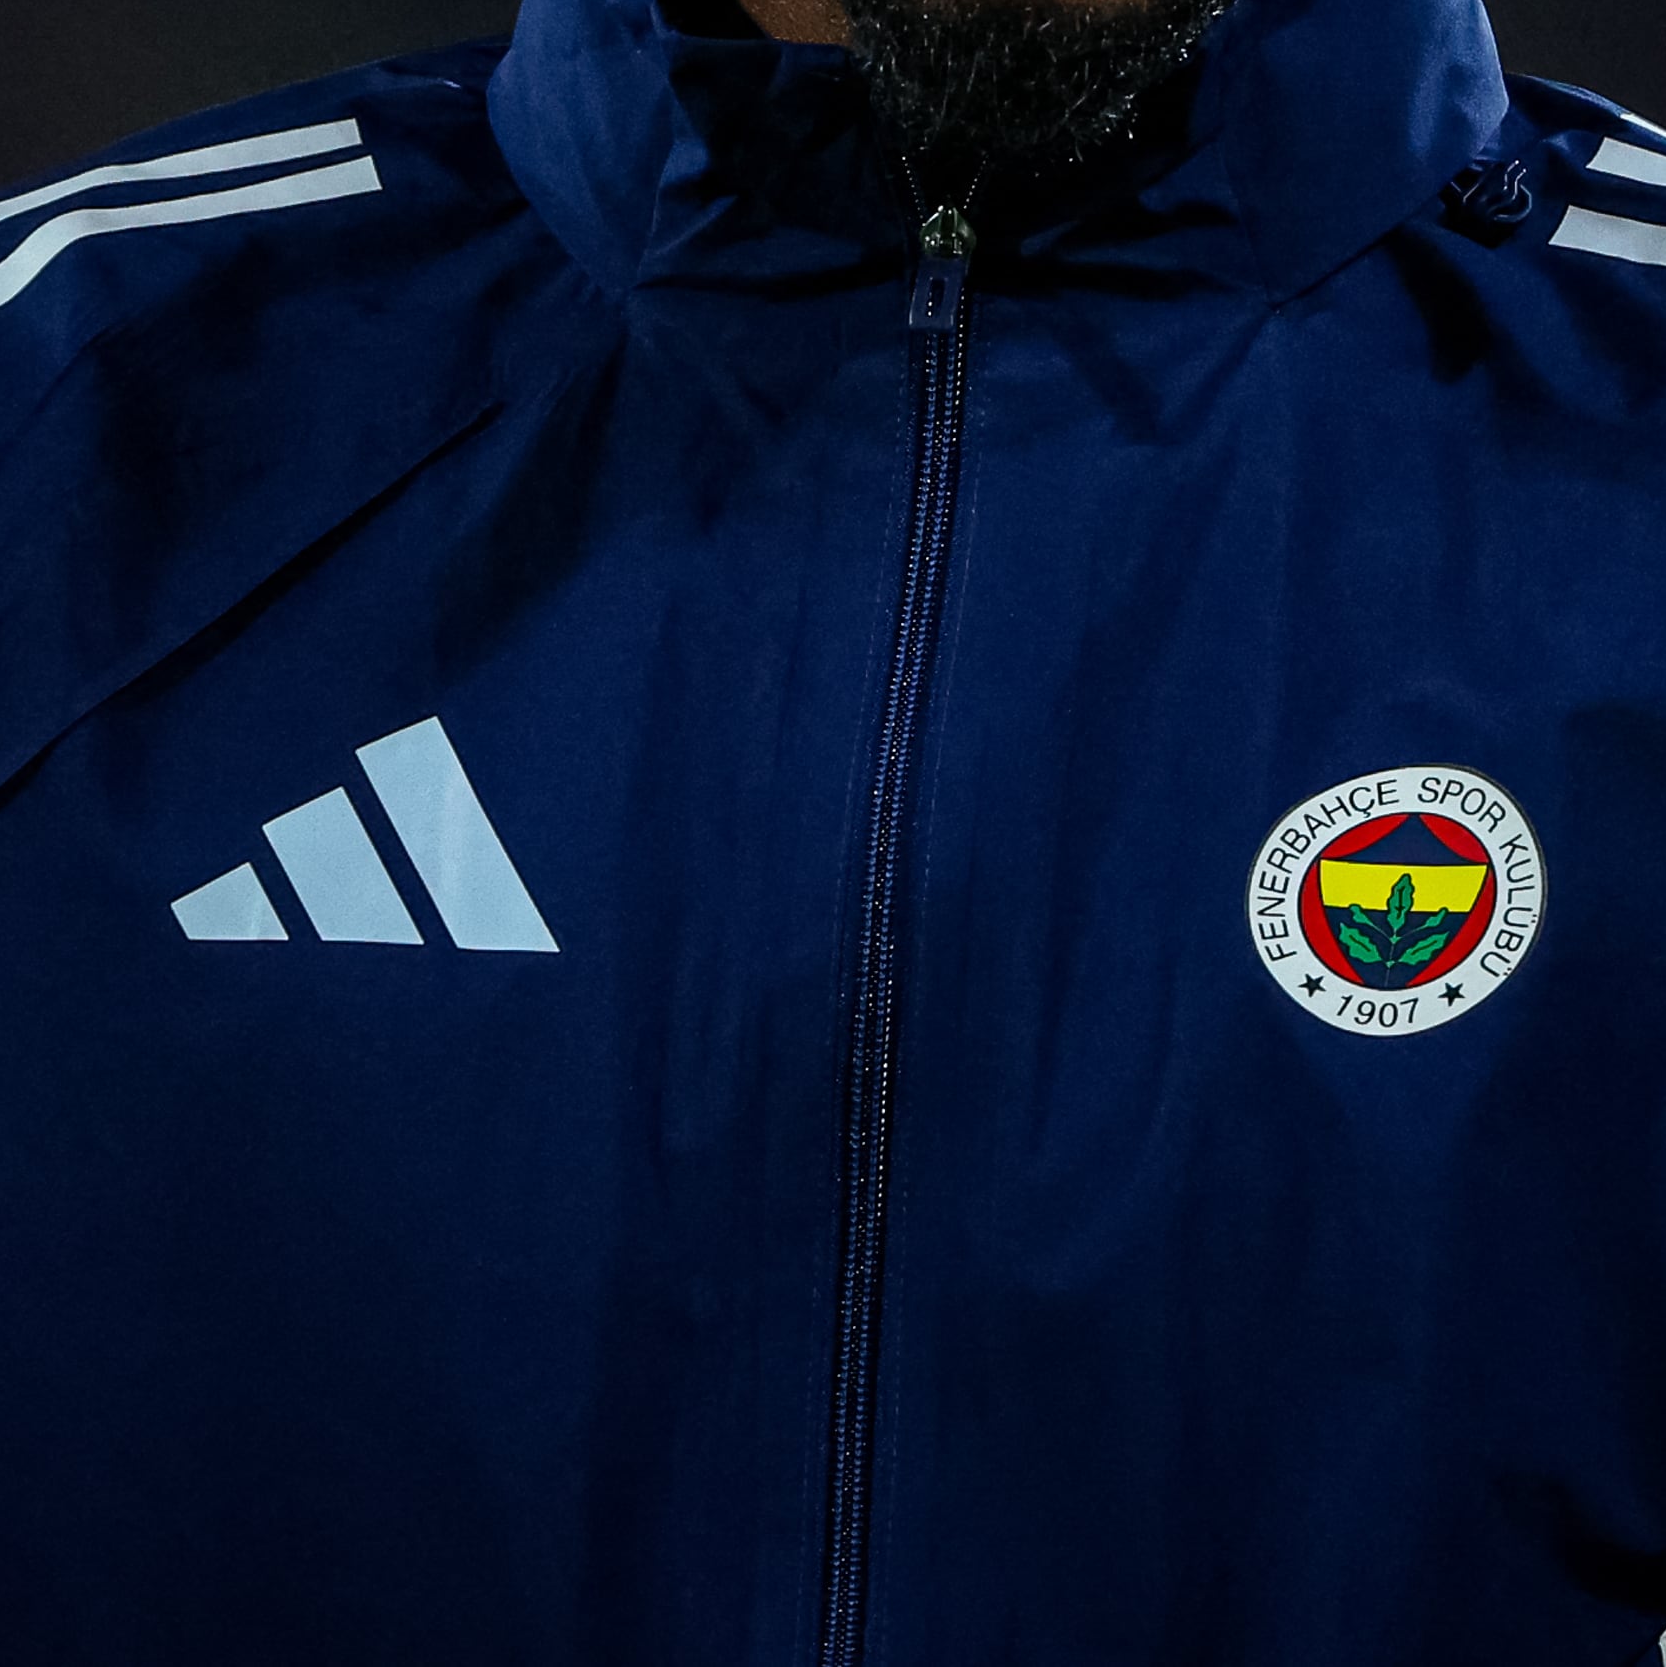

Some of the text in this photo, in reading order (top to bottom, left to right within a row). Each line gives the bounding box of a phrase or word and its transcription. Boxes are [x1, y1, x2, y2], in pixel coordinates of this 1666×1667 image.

[1257, 777, 1538, 978] FENERBAHÇE SPOR KULÜBÜ
[1336, 994, 1420, 1028] 1907
